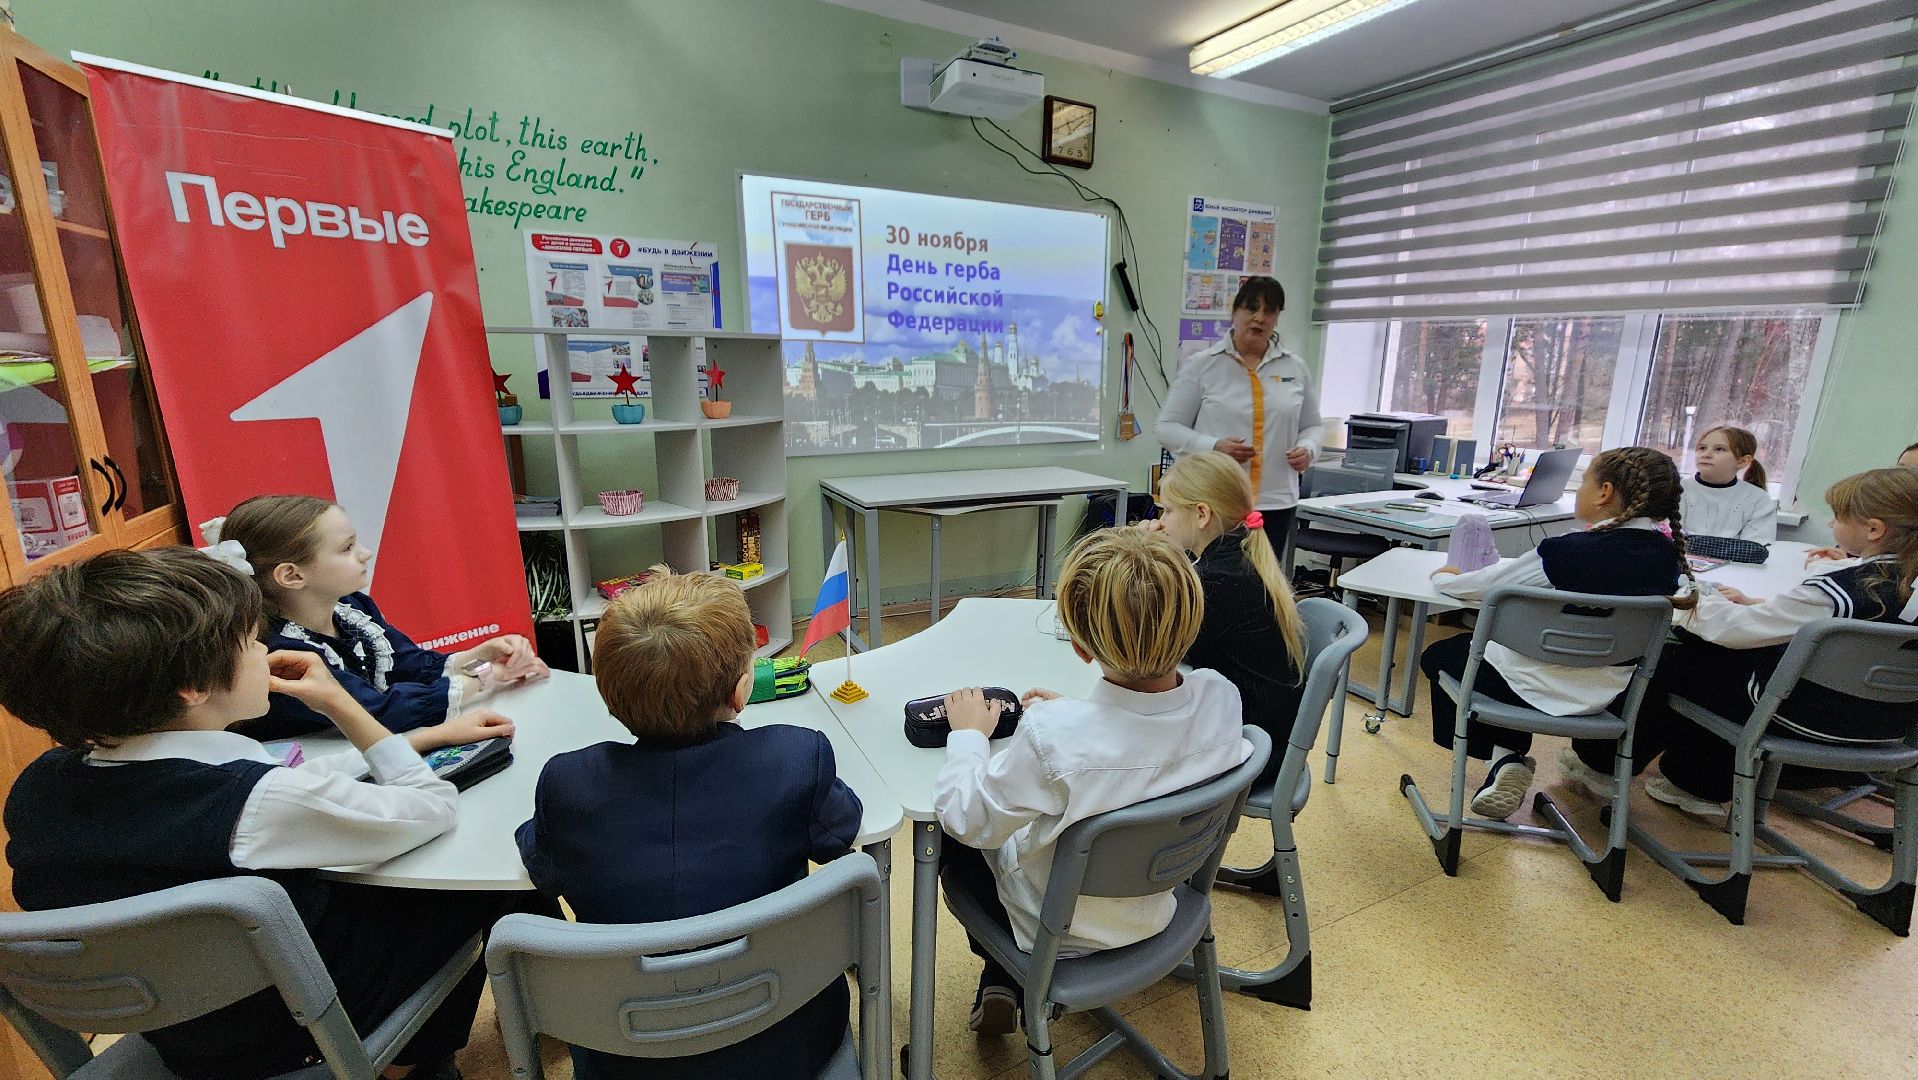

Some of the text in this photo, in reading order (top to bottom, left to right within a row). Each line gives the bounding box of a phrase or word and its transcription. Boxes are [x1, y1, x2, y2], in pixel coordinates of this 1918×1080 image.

[519, 115, 568, 150] this
[459, 147, 495, 178] his
[165, 171, 430, 249] Первые
[464, 186, 588, 229] akespeare
[805, 210, 831, 222] ГЕРБ
[886, 225, 989, 255] 30 ноября
[887, 254, 1001, 282] День герба
[887, 282, 1004, 308] Российской
[887, 310, 1004, 335] Федерации
[415, 623, 501, 651] вижение
